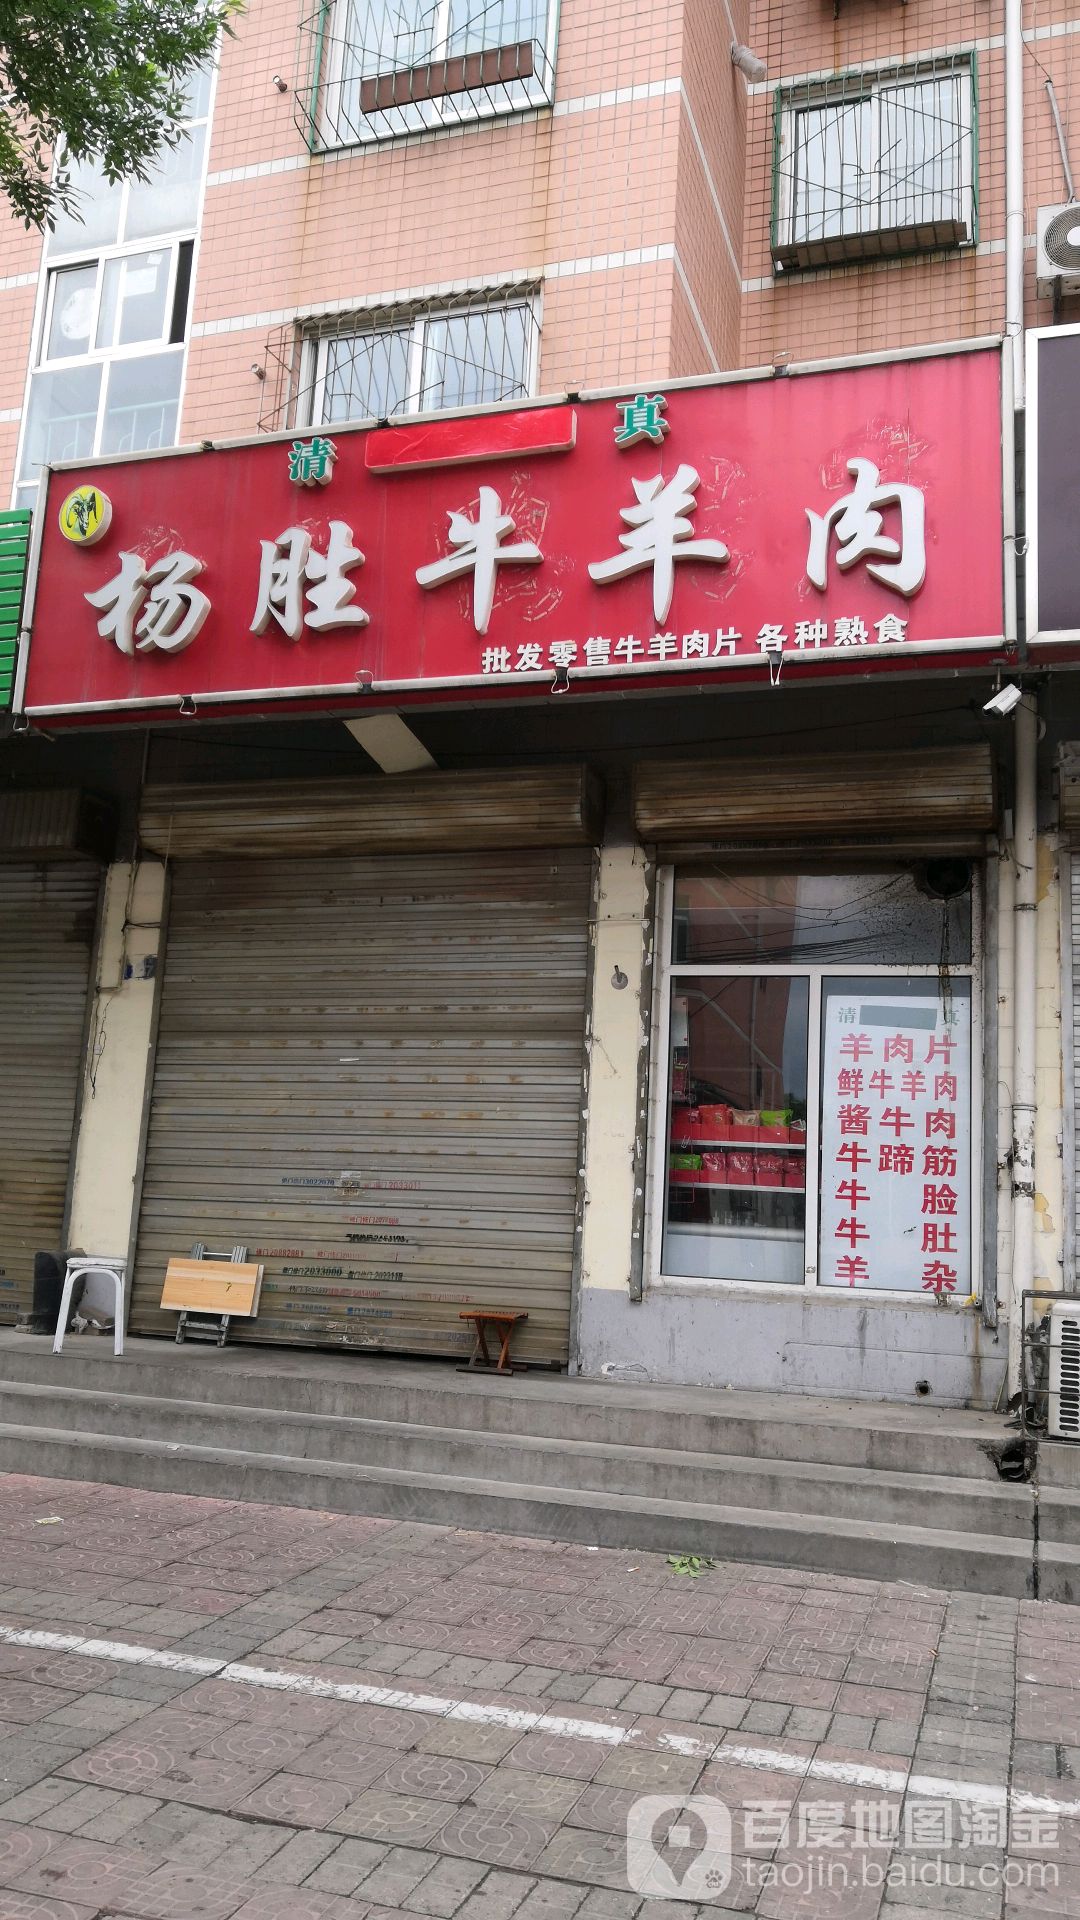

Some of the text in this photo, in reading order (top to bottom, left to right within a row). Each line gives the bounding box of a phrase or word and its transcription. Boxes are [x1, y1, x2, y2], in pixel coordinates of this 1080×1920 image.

[288, 393, 669, 486] 清 真
[84, 457, 926, 656] 杨胜牛羊肉
[756, 613, 908, 654] 各种熟食
[839, 1033, 958, 1065] 羊肉片
[837, 1067, 957, 1102] 鲜牛羊肉
[836, 1103, 957, 1140] 酱牛肉
[835, 1141, 958, 1177] 牛蹄筋
